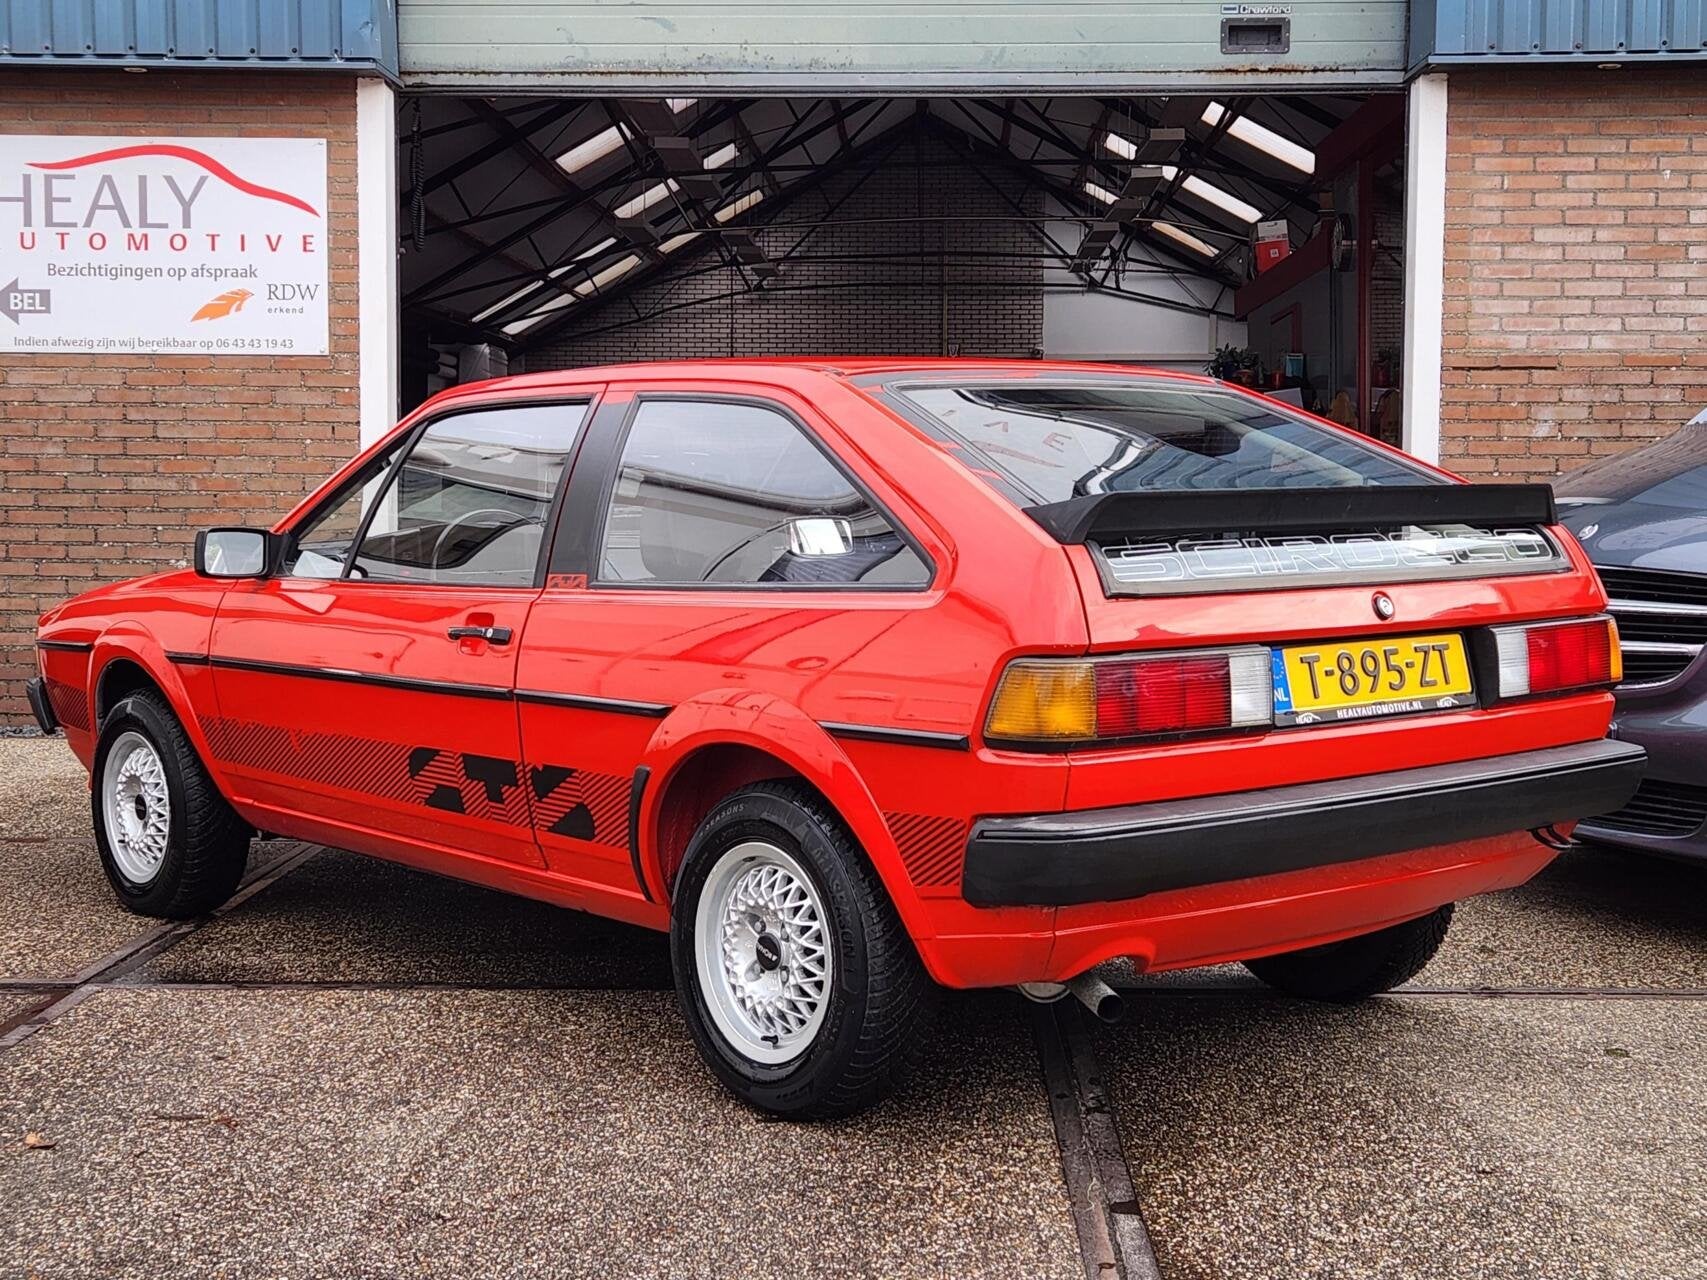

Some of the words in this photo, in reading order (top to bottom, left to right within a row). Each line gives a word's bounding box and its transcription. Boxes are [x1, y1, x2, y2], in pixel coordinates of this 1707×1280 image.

[1240, 4, 1291, 14] Crawford
[0, 173, 209, 229] HEALY
[20, 232, 315, 253] UTOMOTIVE
[47, 263, 163, 280] Bezichtigingen
[167, 267, 187, 281] op
[191, 264, 258, 281] afspraak
[267, 283, 319, 301] RDW
[9, 293, 46, 311] BEL
[268, 306, 304, 314] erkend
[14, 336, 48, 347] Indien
[51, 336, 94, 349] afwezig
[97, 337, 116, 349] zijn
[119, 337, 135, 349] wij
[138, 337, 196, 349] bereikbaar
[199, 340, 213, 350] op
[216, 338, 229, 348] 06
[232, 338, 246, 349] 43
[248, 338, 262, 349] 43
[265, 338, 278, 349] 19
[280, 338, 294, 349] 43
[1300, 643, 1450, 699] T-895-ZT
[1274, 689, 1289, 702] NL
[1336, 701, 1424, 719] HEALYAUTOMOTIVE.NL
